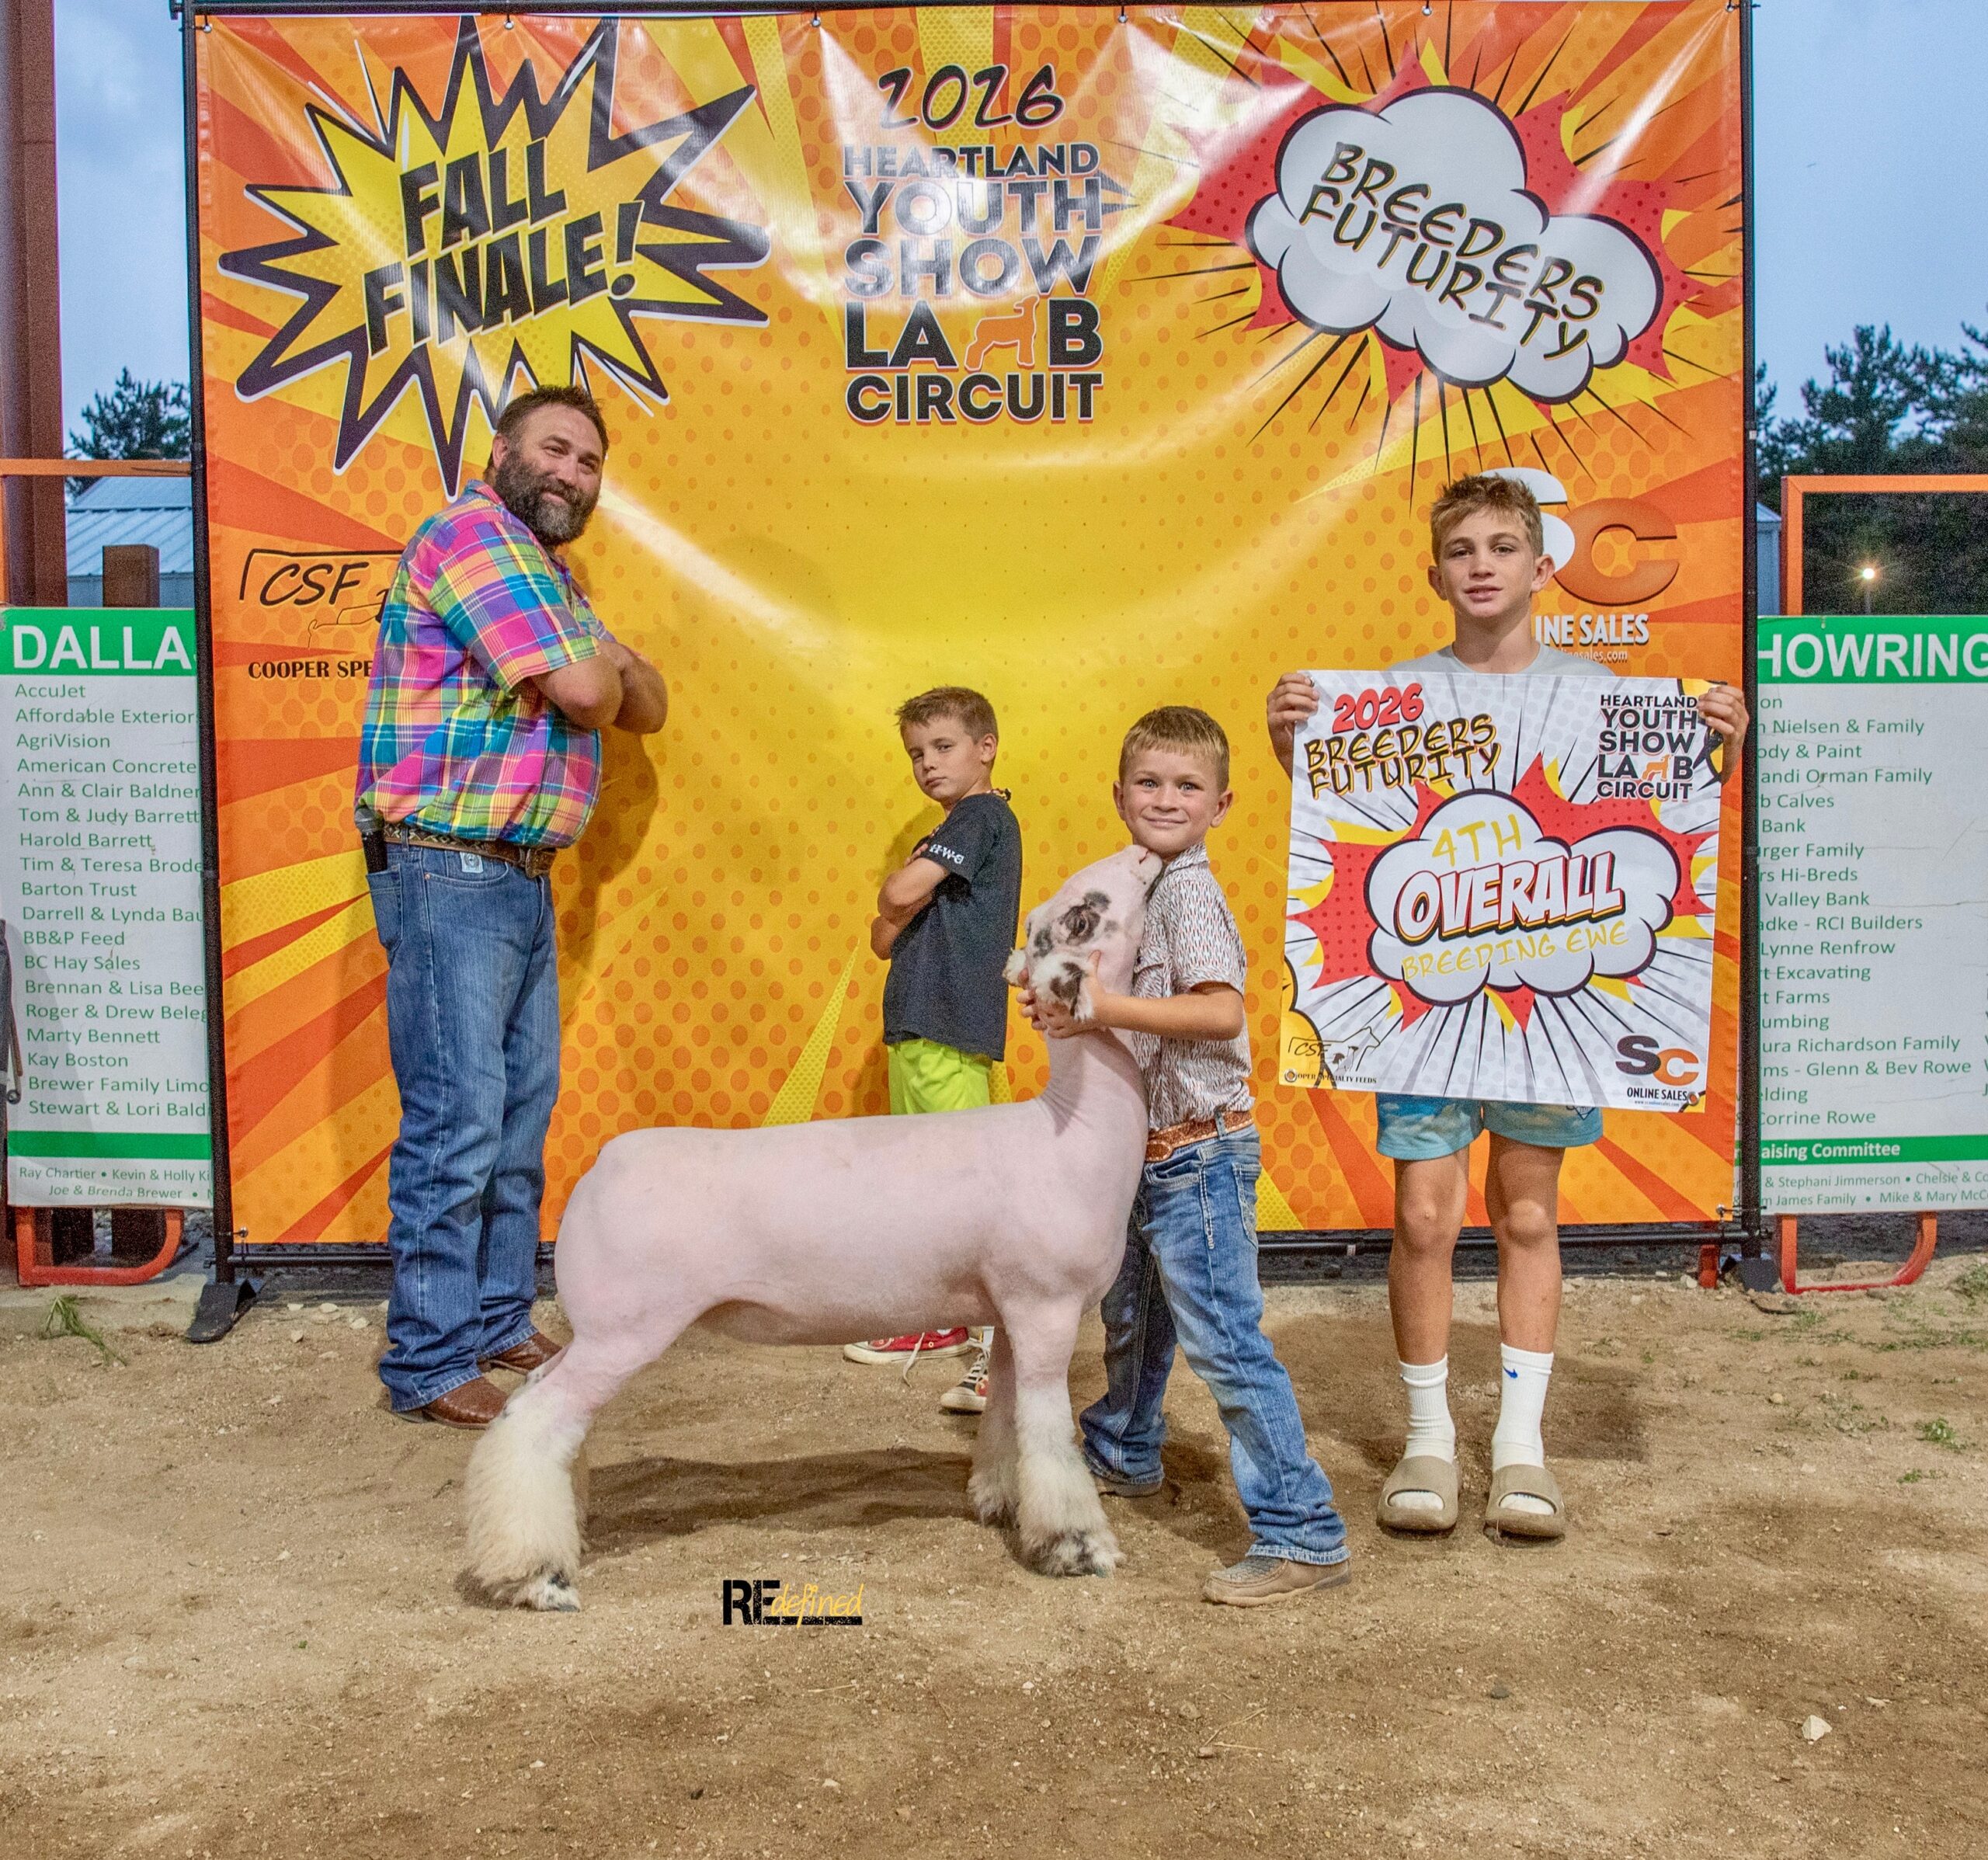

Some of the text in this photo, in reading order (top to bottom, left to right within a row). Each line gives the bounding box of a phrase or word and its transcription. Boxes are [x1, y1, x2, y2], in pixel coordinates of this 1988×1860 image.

[878, 64, 1065, 129] 2026
[844, 142, 1100, 178] HEARTLAND
[400, 137, 568, 260] FALL
[844, 178, 1102, 234] YOUTH
[1322, 142, 1604, 321] BREEDERS
[844, 235, 1102, 297] SHOW
[1299, 185, 1588, 360] FUTURITY
[363, 200, 645, 359] FINALE!
[846, 372, 1103, 422] CIRCUIT
[260, 561, 370, 606] CSF
[1535, 614, 1649, 646] INE SALES
[13, 625, 196, 669] DALLA
[1758, 634, 1988, 678] HOWRING
[248, 660, 373, 678] COOPER SPE
[16, 683, 85, 698] AccuJet
[1333, 683, 1424, 734] 2026
[1600, 695, 1697, 707] HEARTLAND
[1760, 697, 1782, 708] on
[16, 708, 114, 723] Affordable
[1601, 708, 1697, 729] YOUTH
[1773, 720, 1840, 734] Nielsen
[1847, 719, 1860, 733] &
[1867, 718, 1924, 735] Family
[16, 734, 110, 750] AgriVision
[1304, 714, 1496, 771] BREEDERS
[1599, 731, 1695, 753] SHOW
[1758, 744, 1861, 761] ody & Paint
[17, 759, 196, 774] American Concrete
[1308, 743, 1501, 800] FUTURITY
[1761, 768, 1932, 784] andi Orman Family
[18, 784, 54, 797] Ann
[61, 784, 75, 798] &
[82, 784, 123, 797] Clair
[1597, 781, 1692, 798] CIRCUIT
[1778, 794, 1834, 808] Calves
[19, 808, 200, 826] Tom & Judy Barrett
[1762, 819, 1806, 833] Bank
[20, 833, 151, 847] Harold Barrett
[1433, 814, 1521, 866] 4TH
[1758, 843, 1864, 860] rger Family
[20, 857, 203, 872] Tim & Teresa Brode
[1781, 868, 1858, 881] Hi-Breds
[23, 882, 137, 896] Barton Trust
[1393, 851, 1625, 947] OVERALL
[1765, 892, 1870, 909] Valley Bank
[23, 906, 203, 923] Darrell & Lynda Bau
[1759, 916, 1798, 931] adke
[1817, 916, 1844, 930] RCI
[1851, 916, 1923, 930] Builders
[24, 932, 125, 945] BB&P Feed
[1402, 920, 1629, 981] BREEDING EWE
[1761, 940, 1896, 958] Lynne Renfrow
[25, 956, 140, 972] BC Hay Sales
[1778, 965, 1871, 981] Excavating
[26, 980, 203, 995] Brennan & Lisa Bee
[1776, 991, 1830, 1004] Farms
[26, 1004, 78, 1020] Roger
[85, 1005, 99, 1018] &
[106, 1006, 154, 1019] Drew
[1762, 1015, 1830, 1031] umbing
[27, 1029, 160, 1045] Marty Bennett
[1763, 1036, 1960, 1052] ura Richardson Family
[28, 1053, 128, 1068] Kay Boston
[1615, 1035, 1699, 1086] SC
[1761, 1067, 1788, 1077] ms
[1807, 1062, 1858, 1076] Glenn
[1866, 1061, 1879, 1075] &
[1886, 1061, 1917, 1075] Bev
[1924, 1061, 1971, 1074] Rowe
[30, 1077, 210, 1094] Brewer Family Limo
[1627, 1087, 1687, 1100] ONLINE SALES
[1760, 1087, 1808, 1104] lding
[30, 1100, 210, 1116] Stewart & Lori Bald
[1827, 1111, 1875, 1124] Rowe
[1762, 1142, 1900, 1161] aising Committee
[19, 1167, 209, 1183] Ray Chartier Kevin & Holly Ki
[1765, 1177, 1774, 1187] &
[1779, 1177, 1831, 1189] Stephani
[1835, 1175, 1900, 1186] Jimmerson
[1962, 1172, 1970, 1183] &
[1976, 1171, 1988, 1183] Co
[49, 1185, 182, 1198] Joe & Brenda Brewer
[1777, 1195, 1813, 1206] James
[1817, 1193, 1856, 1206] Family
[1880, 1192, 1909, 1203] Mike
[1913, 1191, 1922, 1201] &
[1927, 1191, 1957, 1203] Mary
